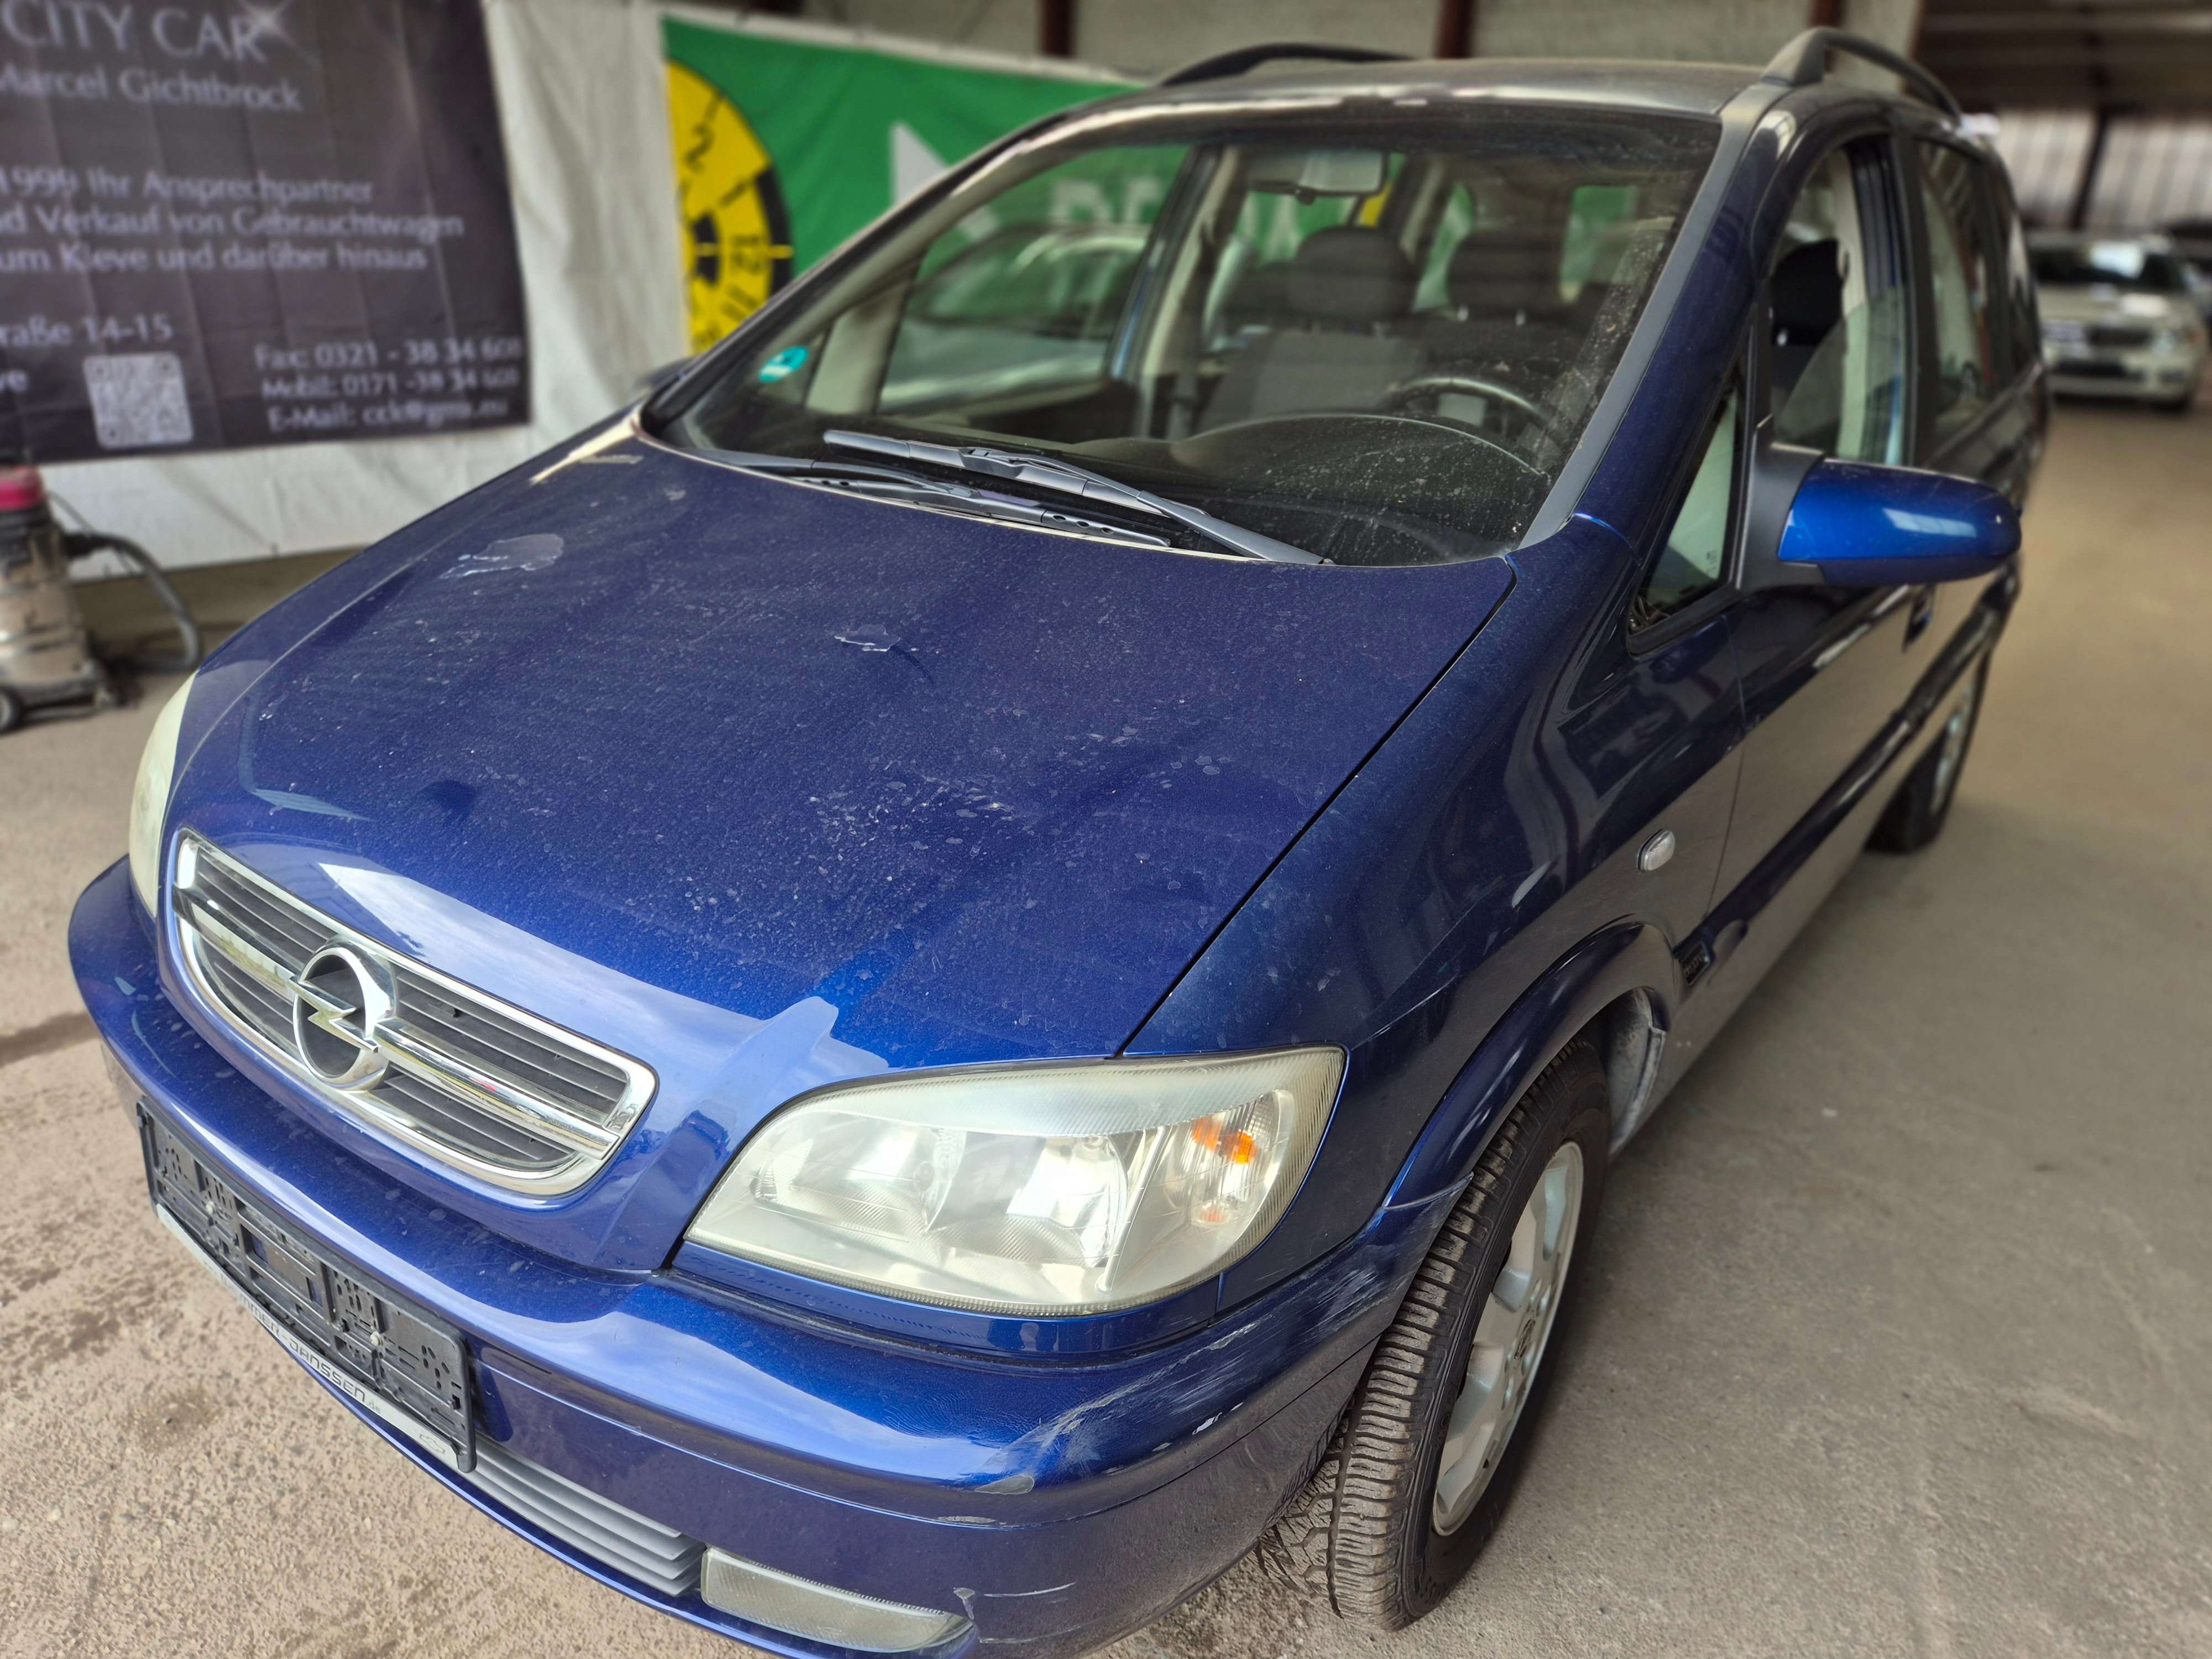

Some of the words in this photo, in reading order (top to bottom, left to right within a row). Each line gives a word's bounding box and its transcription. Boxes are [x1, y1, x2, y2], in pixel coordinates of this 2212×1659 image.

[2, 0, 133, 51] CITY
[152, 7, 267, 62] CAR
[86, 166, 131, 197] Ihr
[143, 169, 373, 208] Ansprechpartner
[34, 202, 160, 234] Verkauf
[169, 211, 225, 234] von
[232, 206, 464, 244] Gebrauchtwagen
[157, 239, 215, 270] und
[222, 239, 328, 269] darüber
[336, 240, 428, 269] hinaus
[82, 312, 173, 344] 14-15
[343, 371, 397, 396] 0171
